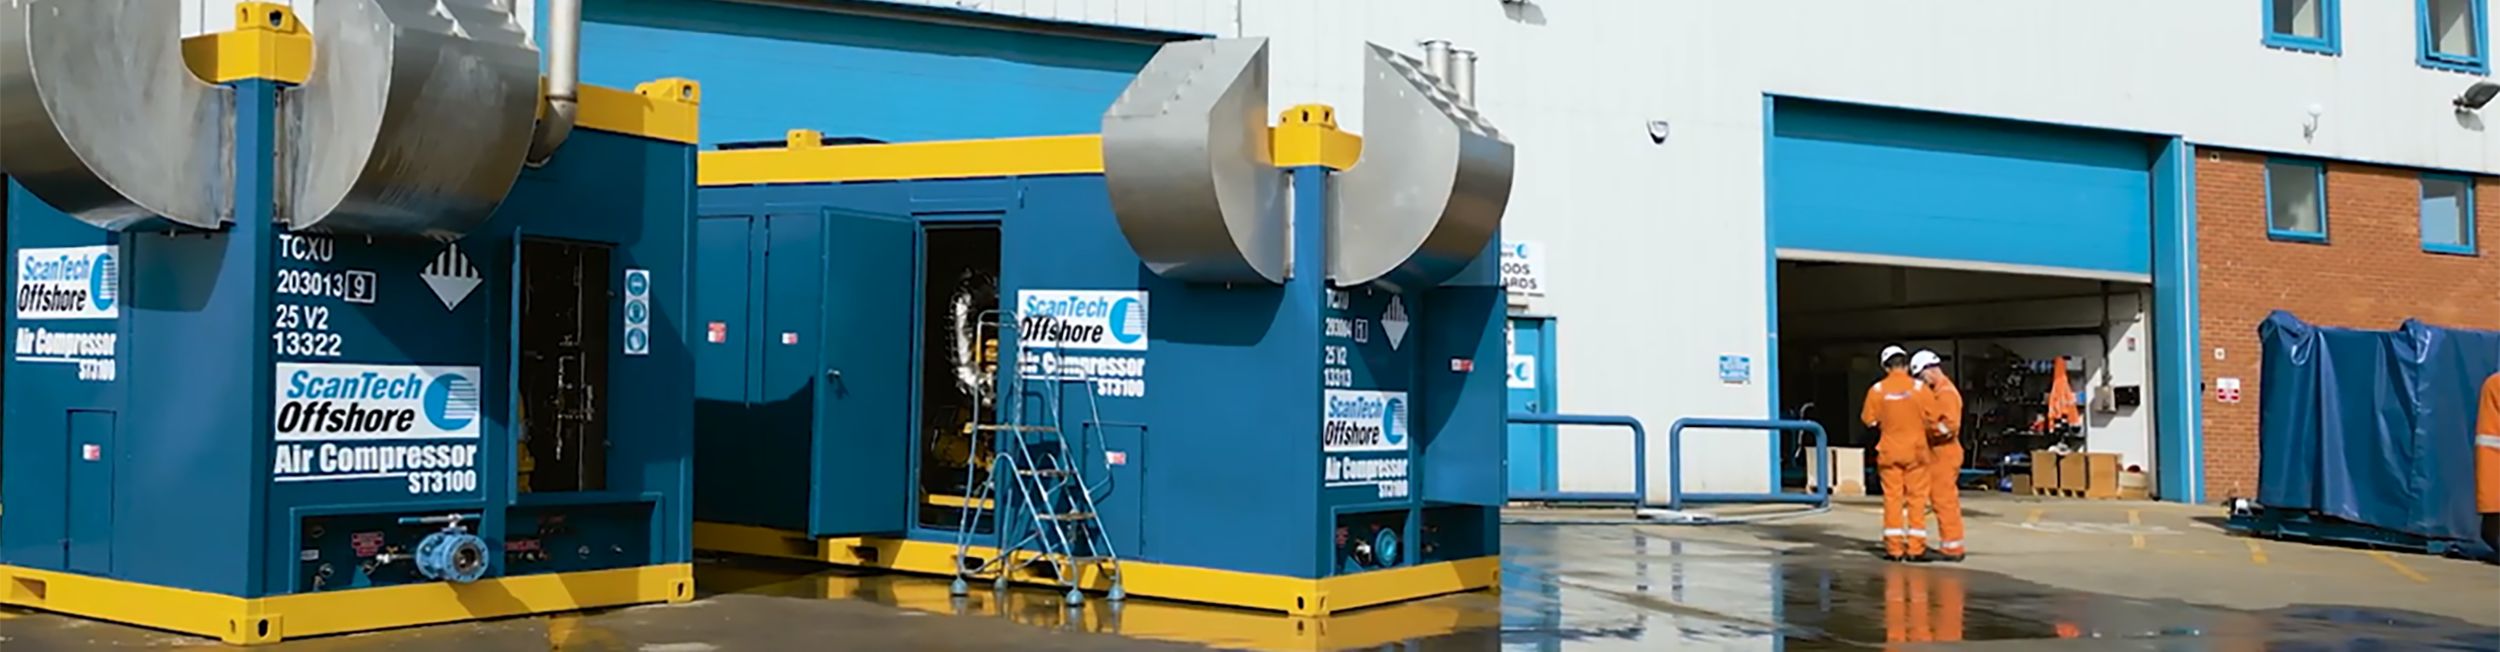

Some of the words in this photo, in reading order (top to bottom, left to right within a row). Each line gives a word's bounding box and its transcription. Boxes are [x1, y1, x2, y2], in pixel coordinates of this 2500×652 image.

[279, 234, 333, 261] TCXU
[23, 254, 90, 281] ScanTech
[276, 269, 343, 297] 203013
[353, 275, 366, 298] 9
[18, 284, 87, 312] Offshore
[1023, 295, 1109, 318] ScanTech
[275, 304, 299, 329] 25
[304, 305, 329, 330] V2
[1021, 316, 1104, 343] Offshore
[272, 331, 342, 356] 13322
[286, 369, 422, 399] ScanTech
[277, 401, 415, 433] Offshore
[1328, 395, 1383, 419] ScanTech
[1325, 420, 1380, 446] Offshore
[274, 444, 314, 474] Air
[319, 443, 477, 473] Compressor
[408, 470, 477, 494] ST3100
